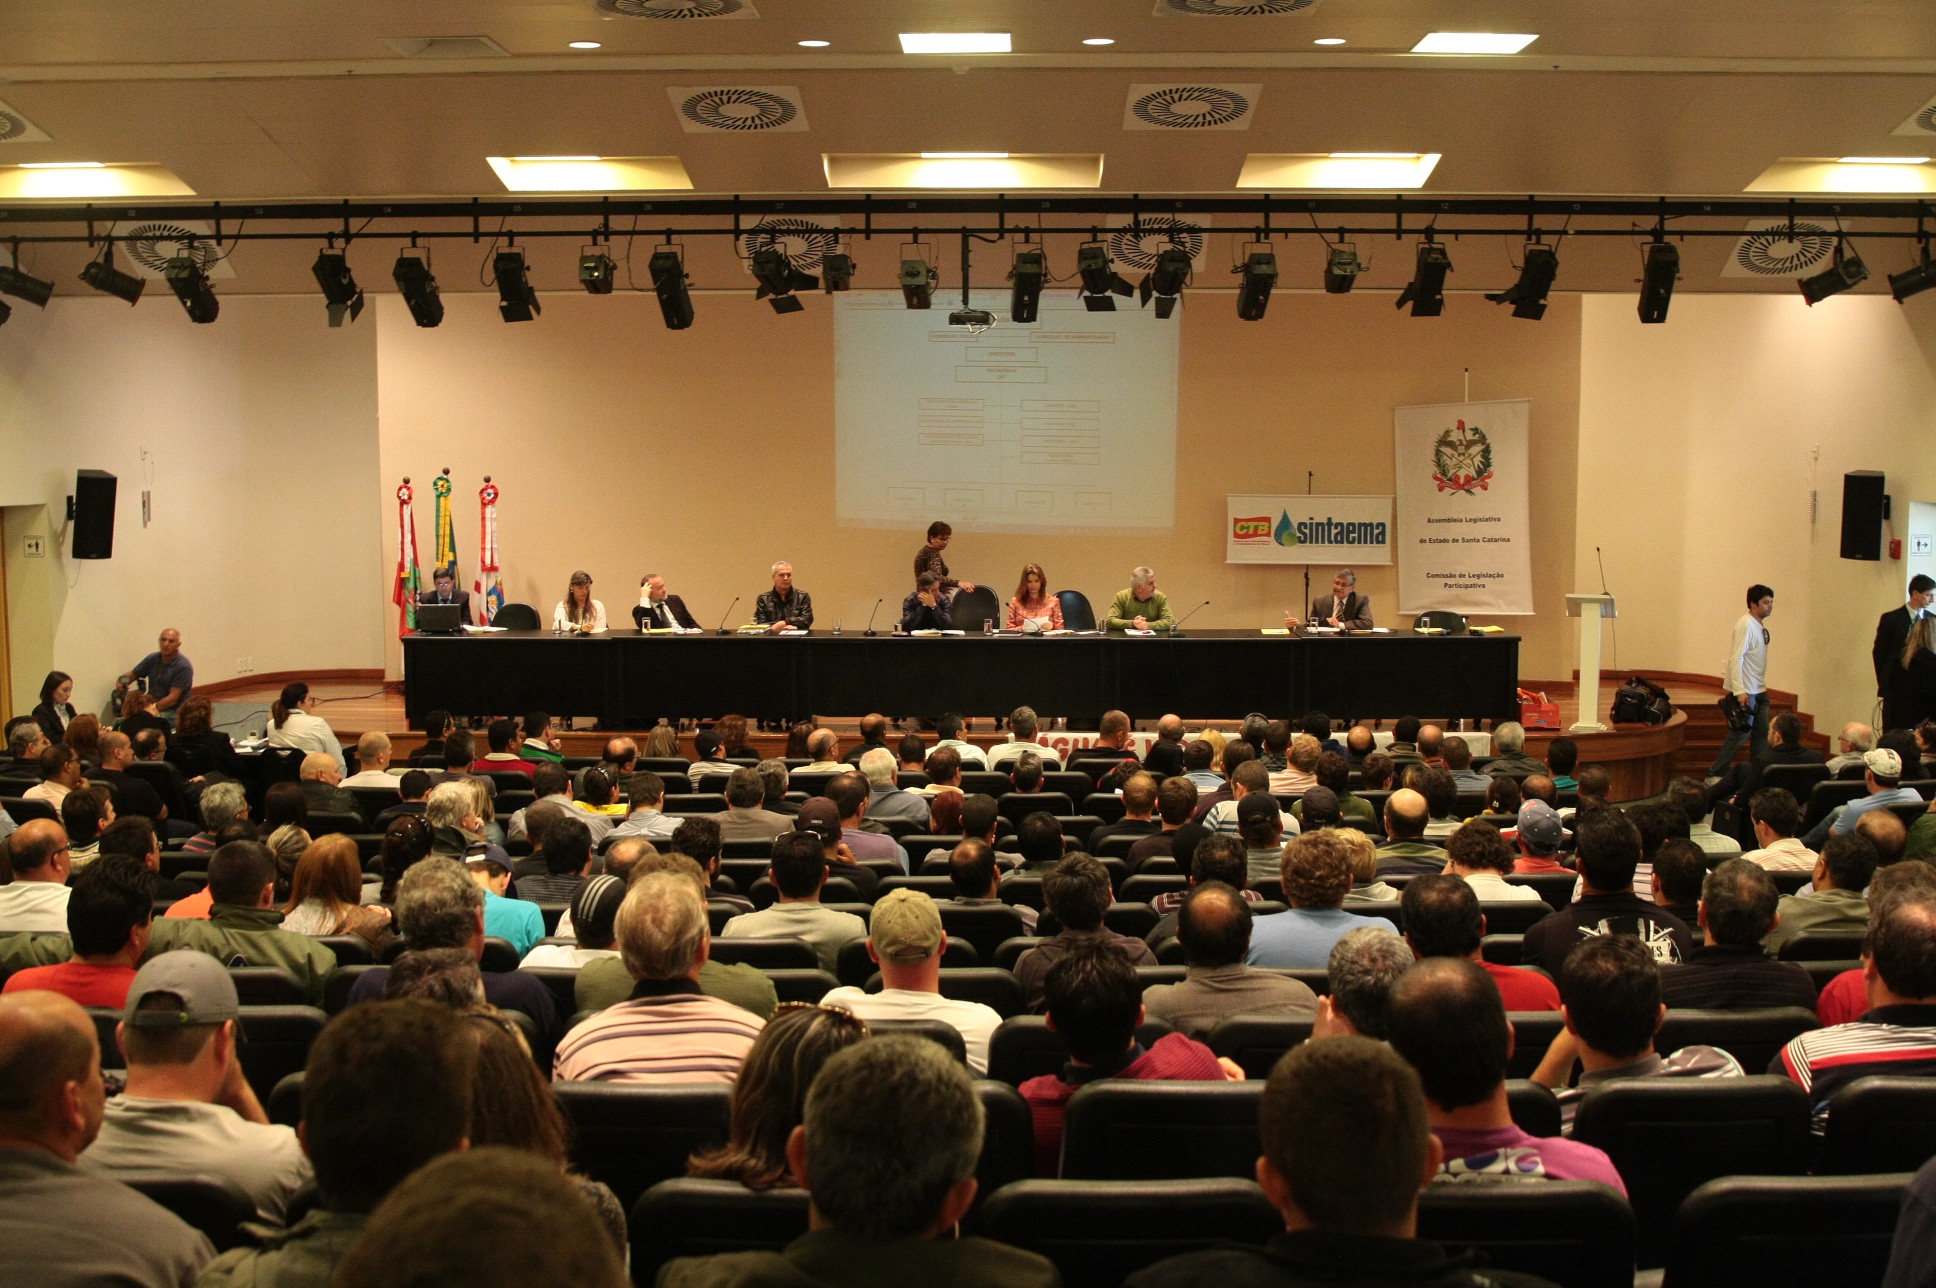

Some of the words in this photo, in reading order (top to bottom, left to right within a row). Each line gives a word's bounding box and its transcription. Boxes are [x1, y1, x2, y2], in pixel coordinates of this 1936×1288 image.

[1465, 516, 1501, 524] Legislativa
[1235, 521, 1270, 534] CTB
[1297, 517, 1387, 545] sintaema
[1444, 582, 1486, 590] Participativa
